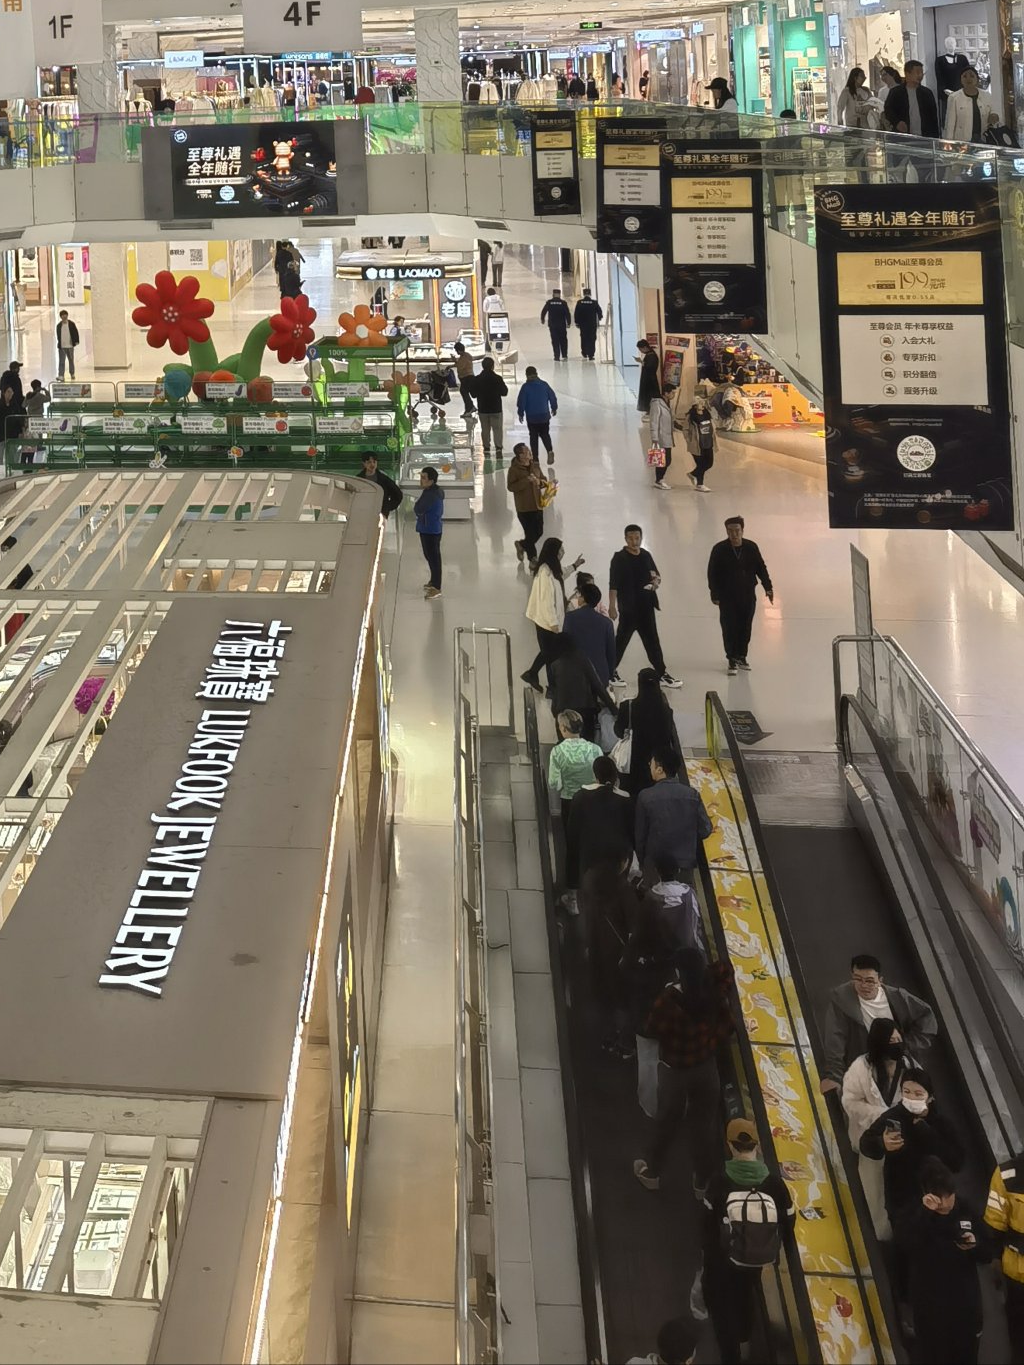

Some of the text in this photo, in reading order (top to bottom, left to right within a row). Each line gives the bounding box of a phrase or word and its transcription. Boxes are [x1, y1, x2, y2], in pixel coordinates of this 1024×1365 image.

[283, 1, 321, 26] 4F
[48, 14, 73, 39] 1F
[187, 146, 242, 162] 至尊礼遇
[187, 161, 242, 177] 全年随行
[824, 195, 839, 204] BHG
[840, 211, 976, 227] 至尊礼遇全年随行
[874, 258, 943, 267] BHGMall至尊会员
[398, 268, 442, 278] LAOMIAO
[898, 271, 929, 290] 199
[441, 302, 471, 318] 老庙
[870, 322, 954, 331] 至尊会员 年卡尊享权益
[901, 336, 936, 345] 入会大礼
[902, 353, 937, 362] 专享折扣
[903, 370, 937, 379] 积分翻倍
[904, 387, 937, 395] 服务升级
[166, 709, 252, 812] LUKFOOK
[98, 811, 218, 997] JEWELLERY
